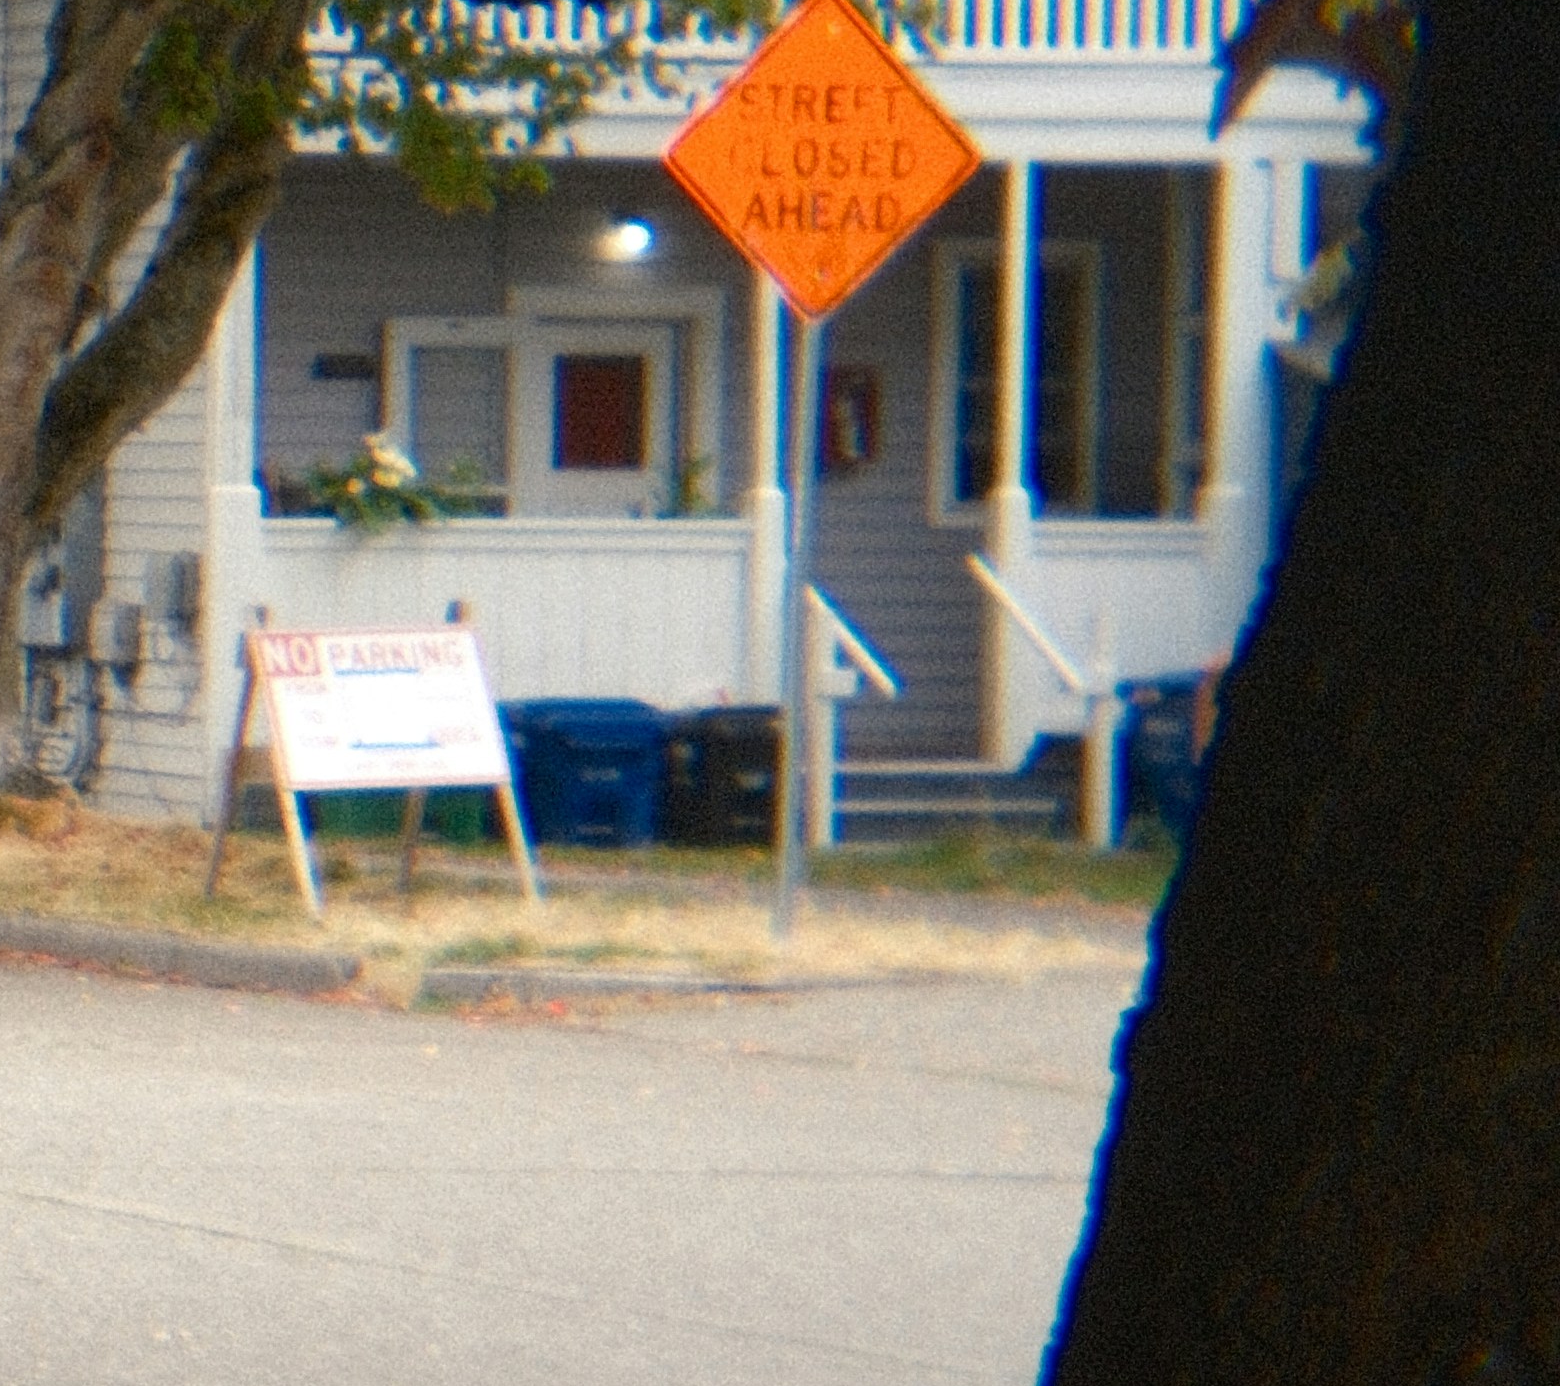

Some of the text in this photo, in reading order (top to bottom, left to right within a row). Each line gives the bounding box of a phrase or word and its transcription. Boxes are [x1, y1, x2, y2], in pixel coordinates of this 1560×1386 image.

[739, 82, 905, 125] STREET
[741, 191, 902, 233] AHEAD
[265, 635, 465, 675] NO PARKING
